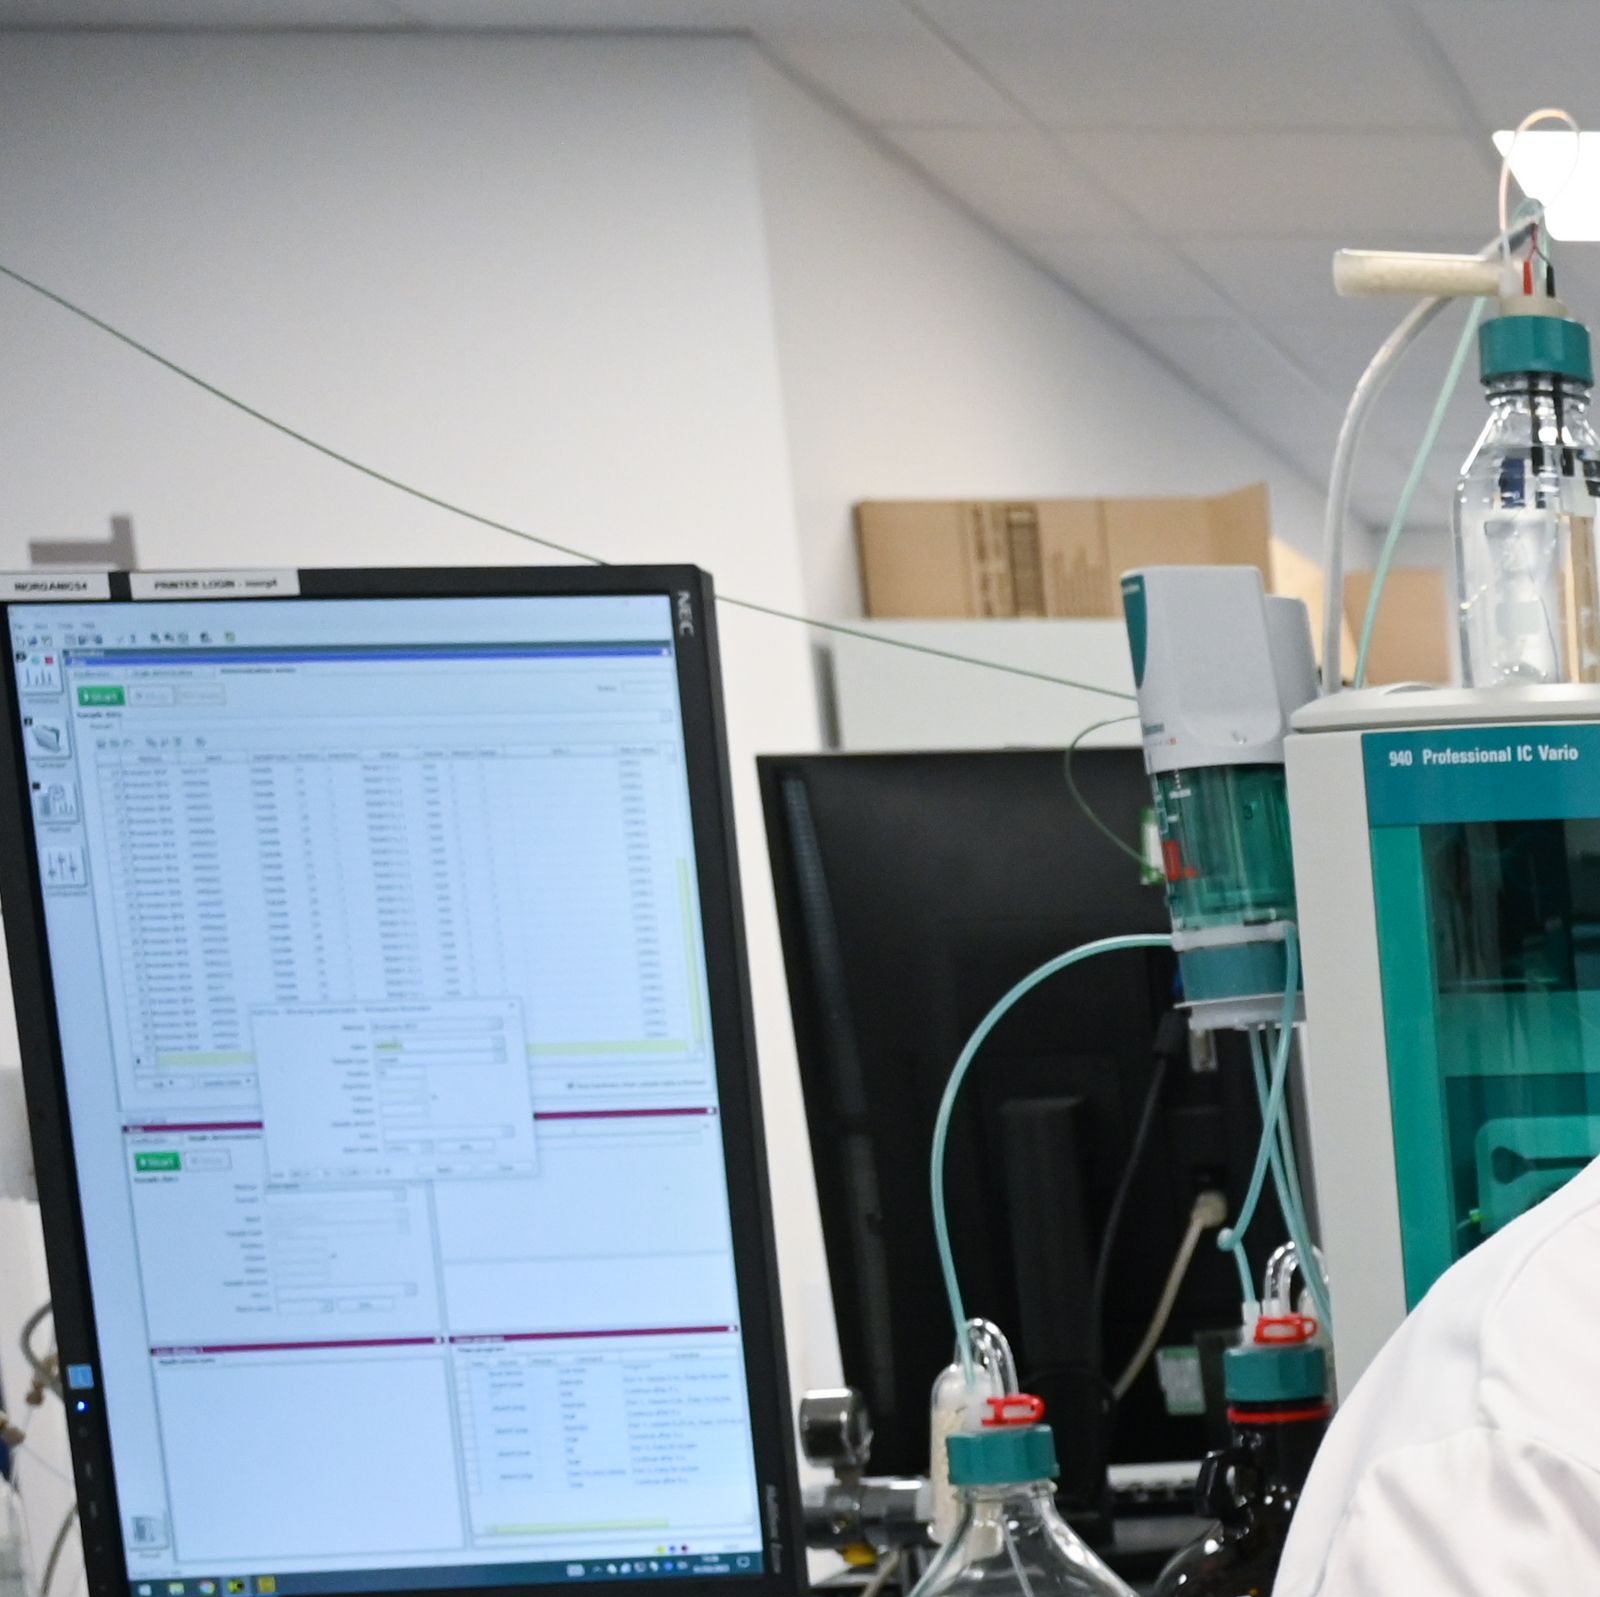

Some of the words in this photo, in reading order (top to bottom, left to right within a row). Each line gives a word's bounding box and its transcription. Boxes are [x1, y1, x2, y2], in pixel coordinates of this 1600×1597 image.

[677, 590, 695, 637] NEC
[1388, 750, 1413, 767] 940
[1422, 745, 1512, 766] Professional
[1516, 745, 1533, 762] IC
[1538, 744, 1579, 762] Vario
